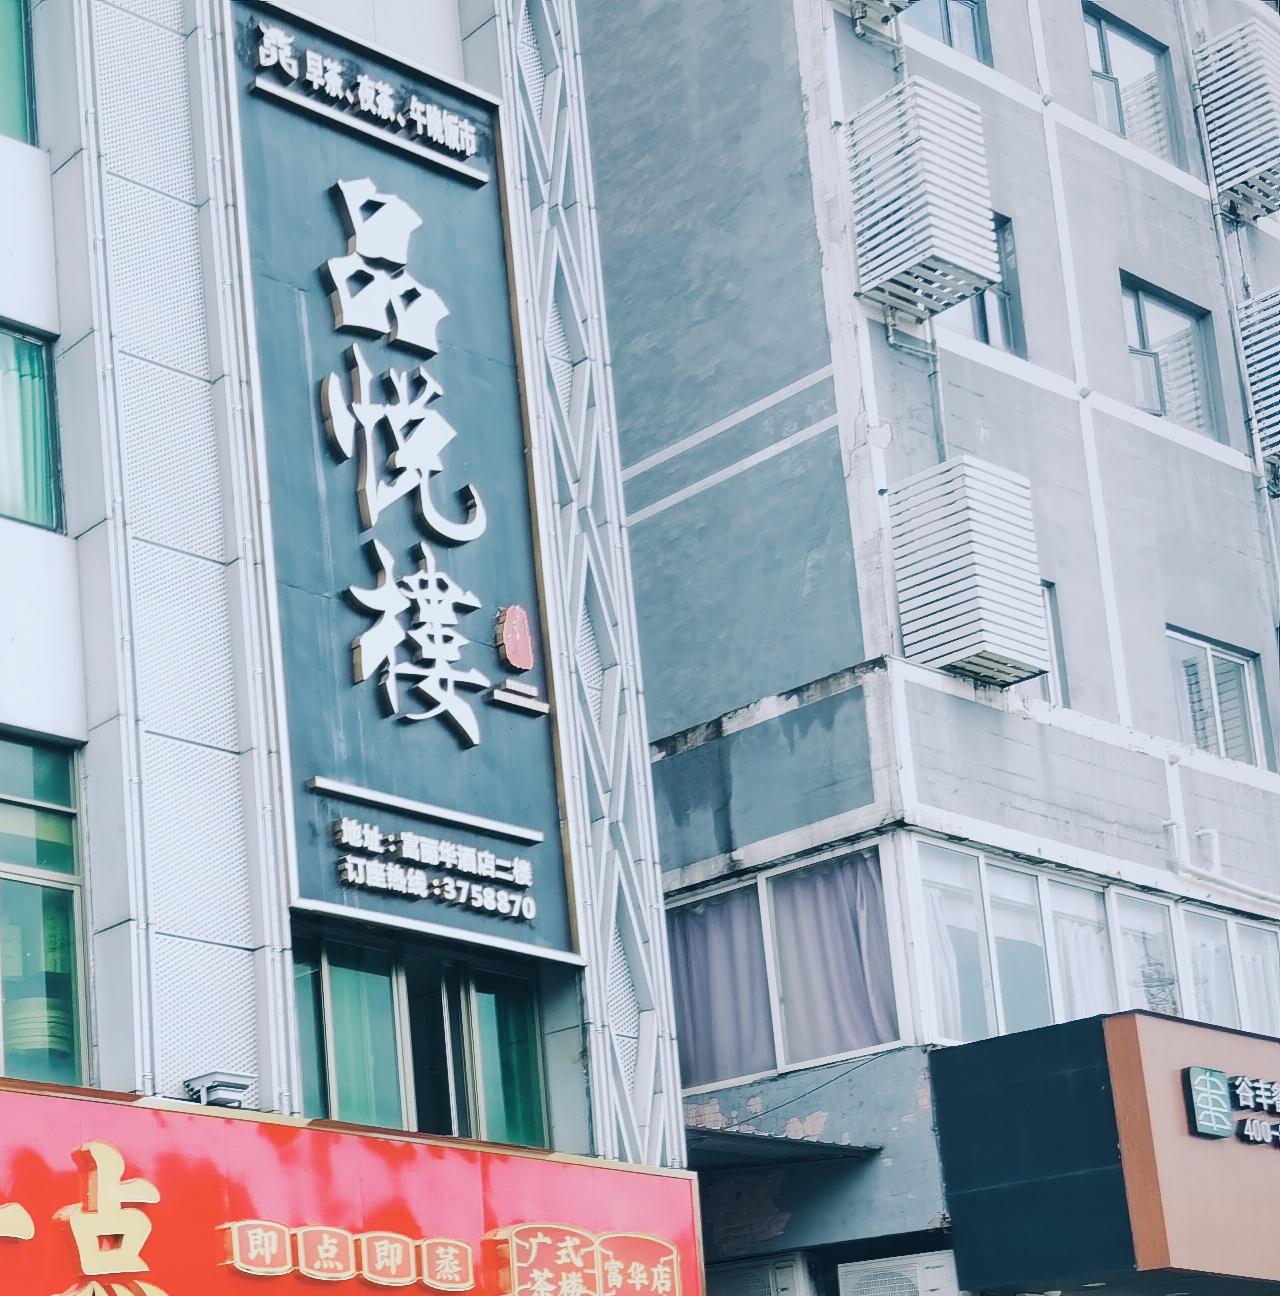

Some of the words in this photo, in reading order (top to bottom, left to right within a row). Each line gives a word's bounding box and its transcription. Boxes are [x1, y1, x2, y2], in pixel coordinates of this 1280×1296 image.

[247, 1227, 462, 1282] 即点即蒸
[528, 1233, 584, 1268] 广式
[605, 1258, 672, 1296] 富华店
